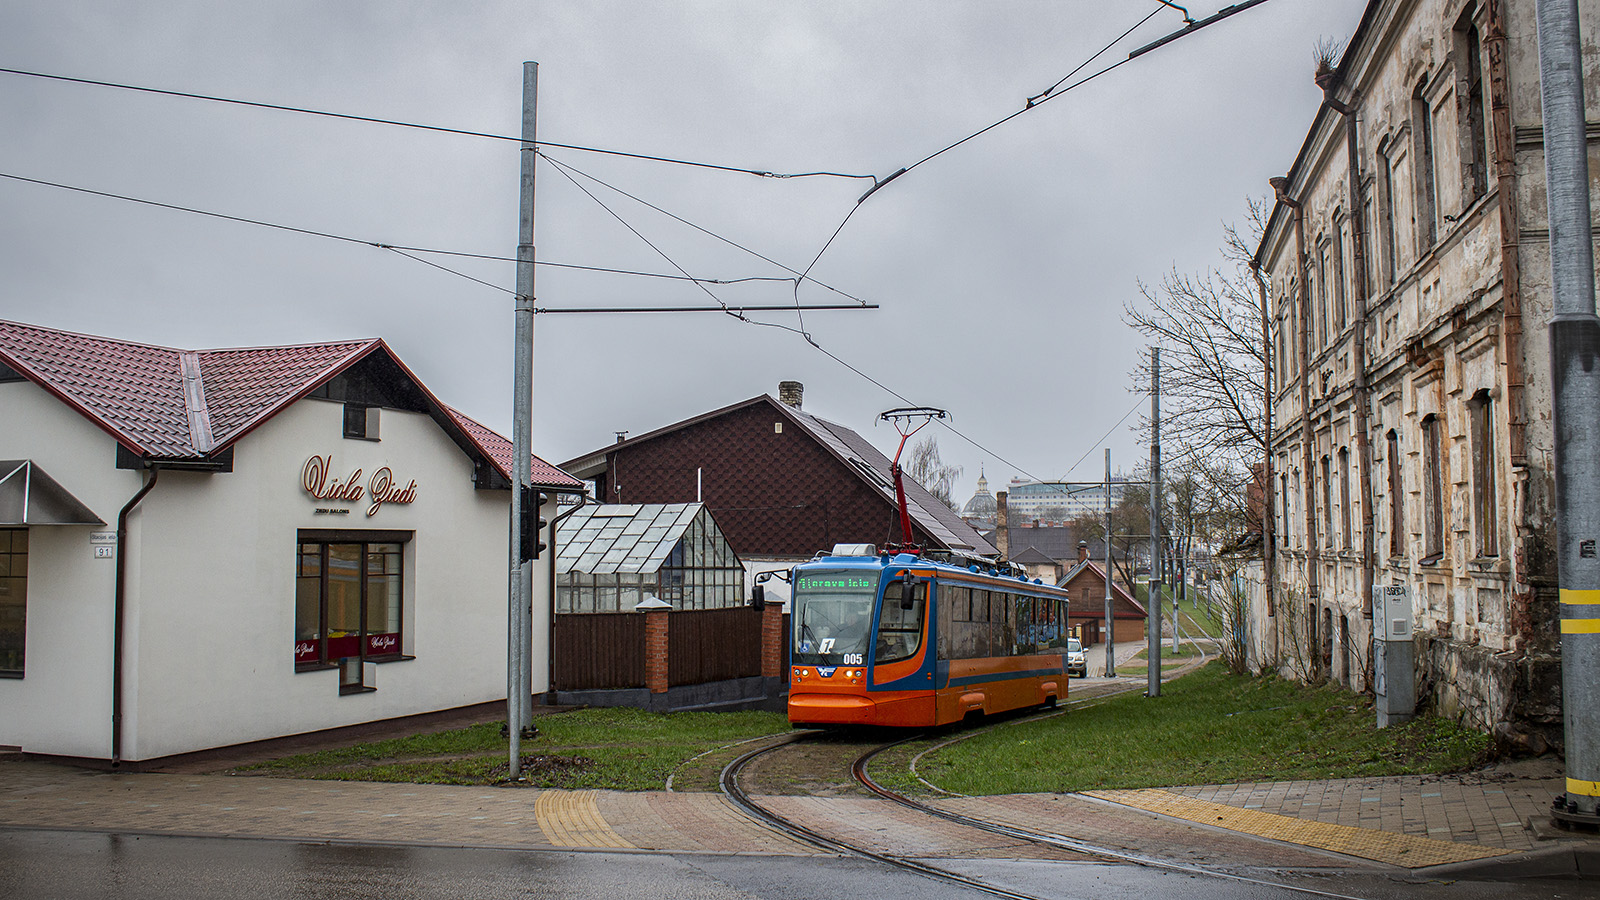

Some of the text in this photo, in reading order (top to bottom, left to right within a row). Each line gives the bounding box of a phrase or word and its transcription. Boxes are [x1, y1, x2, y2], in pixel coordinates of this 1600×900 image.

[302, 454, 417, 517] Viola Ziedi
[98, 548, 108, 556] 91
[843, 653, 863, 665] 005
